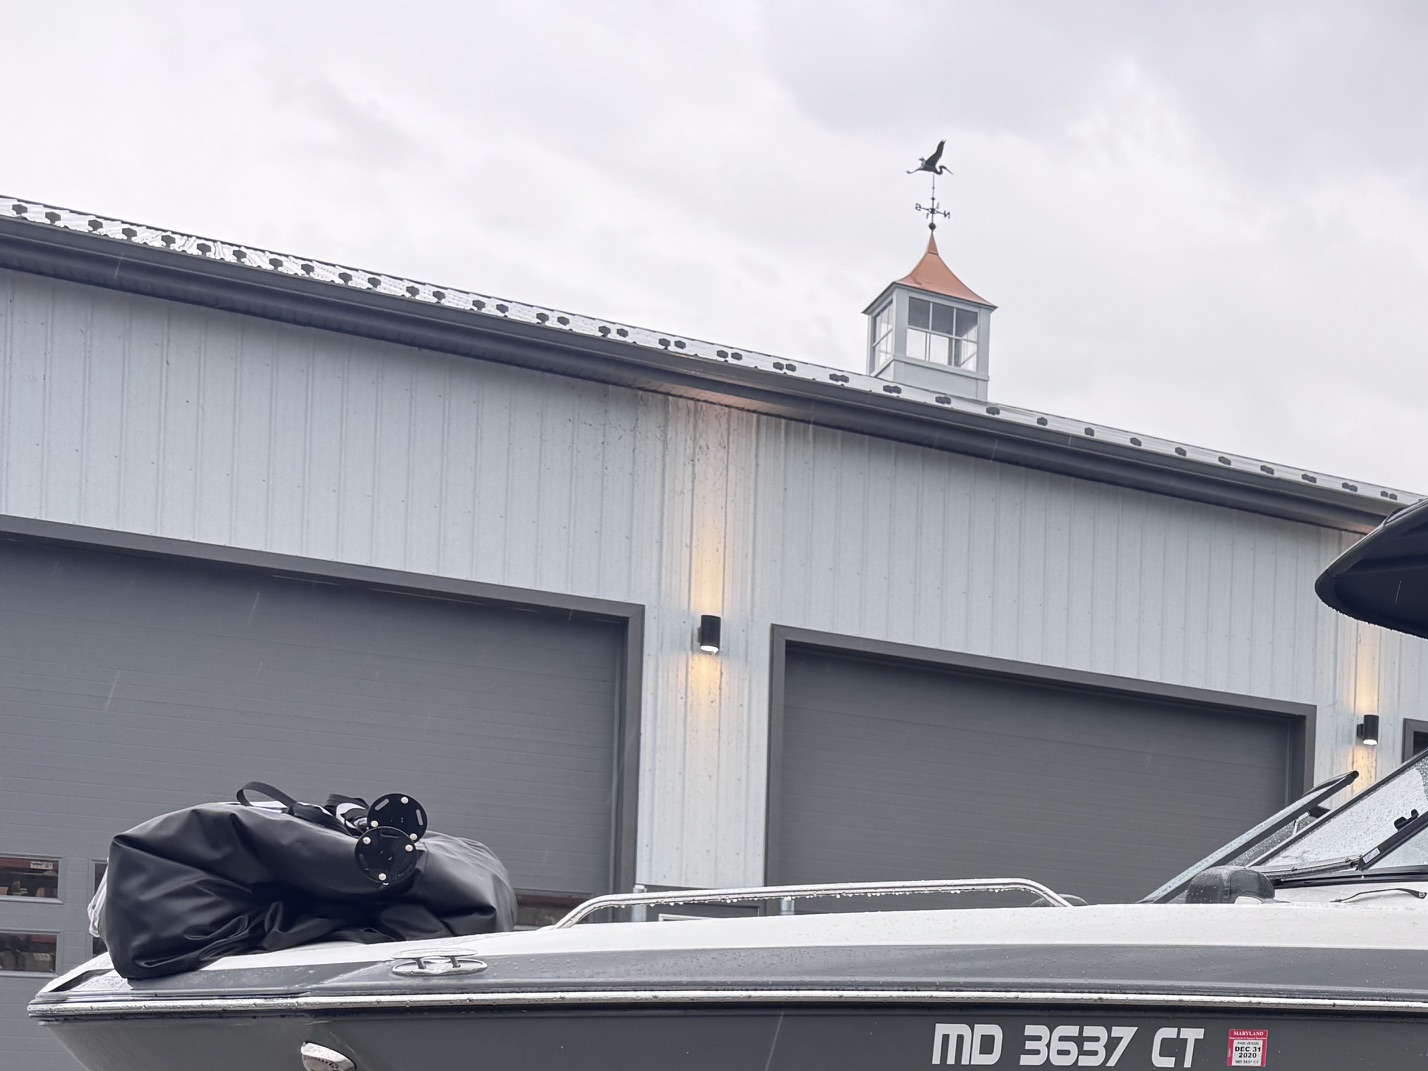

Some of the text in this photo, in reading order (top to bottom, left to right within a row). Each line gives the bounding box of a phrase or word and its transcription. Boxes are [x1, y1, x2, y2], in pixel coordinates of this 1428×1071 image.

[931, 1023, 1204, 1068] MD 3637 CT
